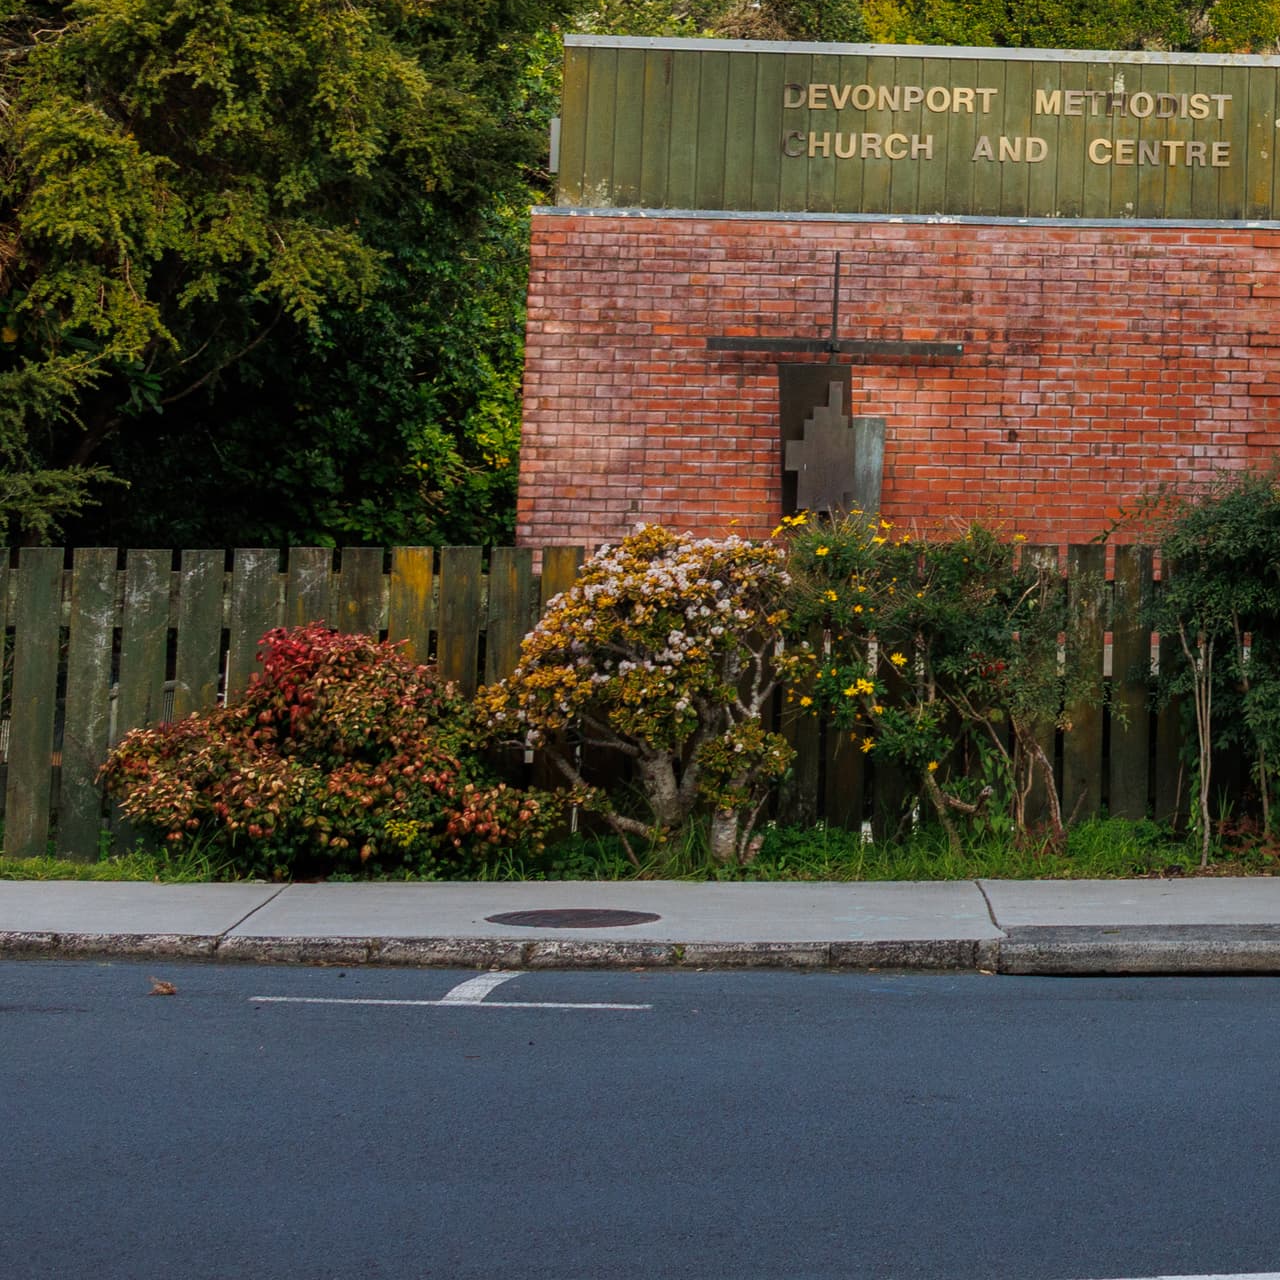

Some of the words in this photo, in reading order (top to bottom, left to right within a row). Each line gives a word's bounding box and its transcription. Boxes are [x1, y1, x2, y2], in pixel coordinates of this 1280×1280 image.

[784, 83, 998, 114] DEVONPORT
[1034, 89, 1232, 120] METHODIST
[783, 129, 933, 160] CHURCH
[972, 135, 1048, 162] AND
[1088, 138, 1231, 167] CENTRE
